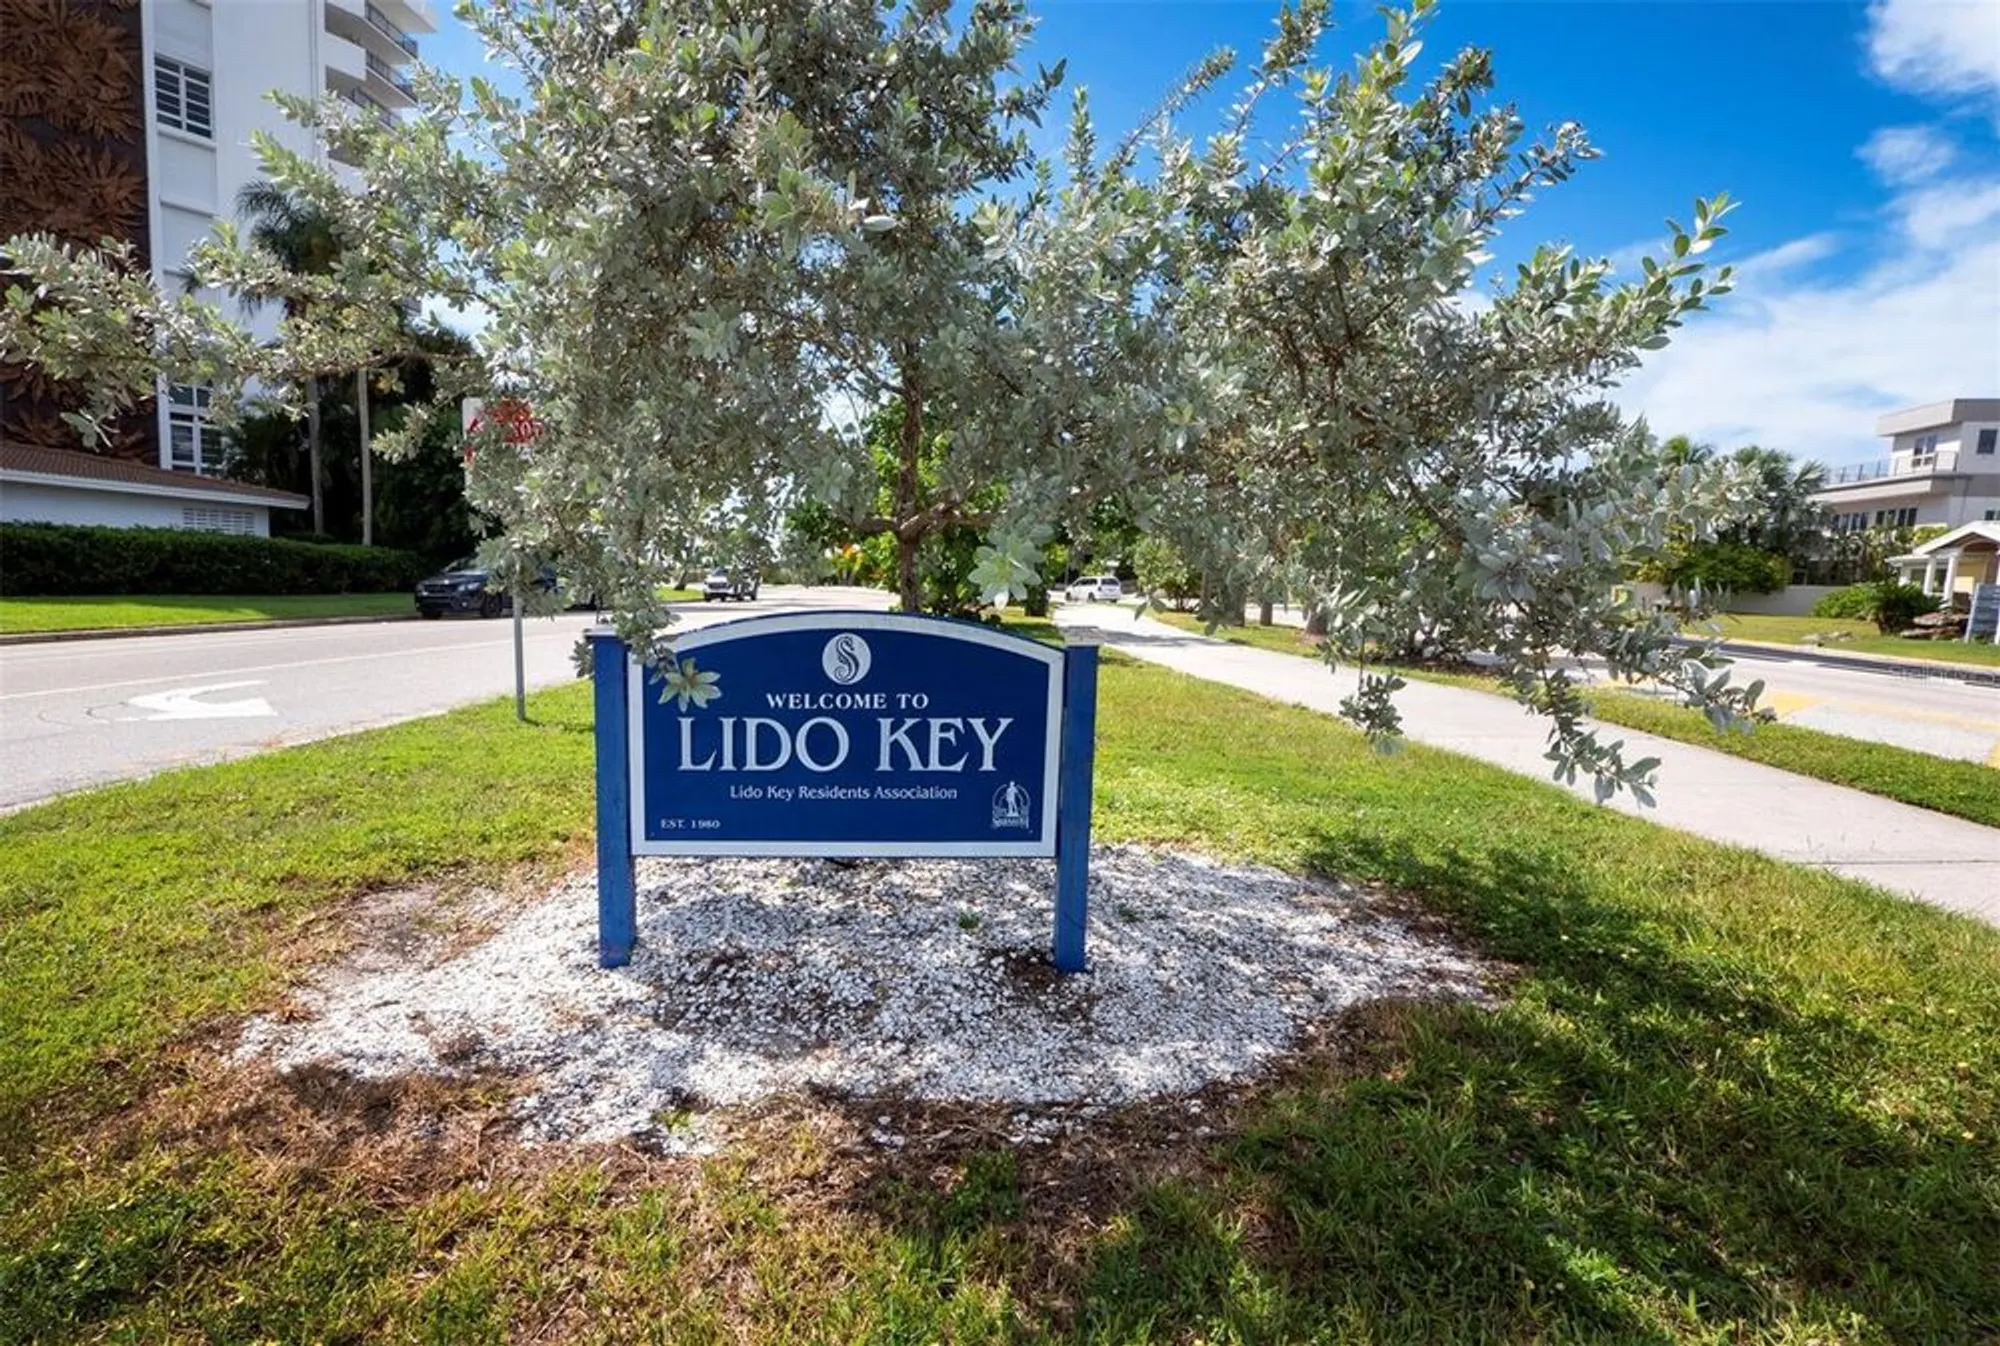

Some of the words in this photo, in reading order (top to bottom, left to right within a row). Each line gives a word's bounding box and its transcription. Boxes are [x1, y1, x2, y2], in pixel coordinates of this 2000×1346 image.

[766, 692, 888, 709] WELCOME
[896, 693, 930, 709] TO
[677, 716, 850, 772] LIDO
[875, 717, 1014, 772] KEY
[729, 785, 763, 799] Lido
[767, 785, 793, 802] Key
[798, 785, 871, 799] Residents
[873, 785, 958, 799] Association
